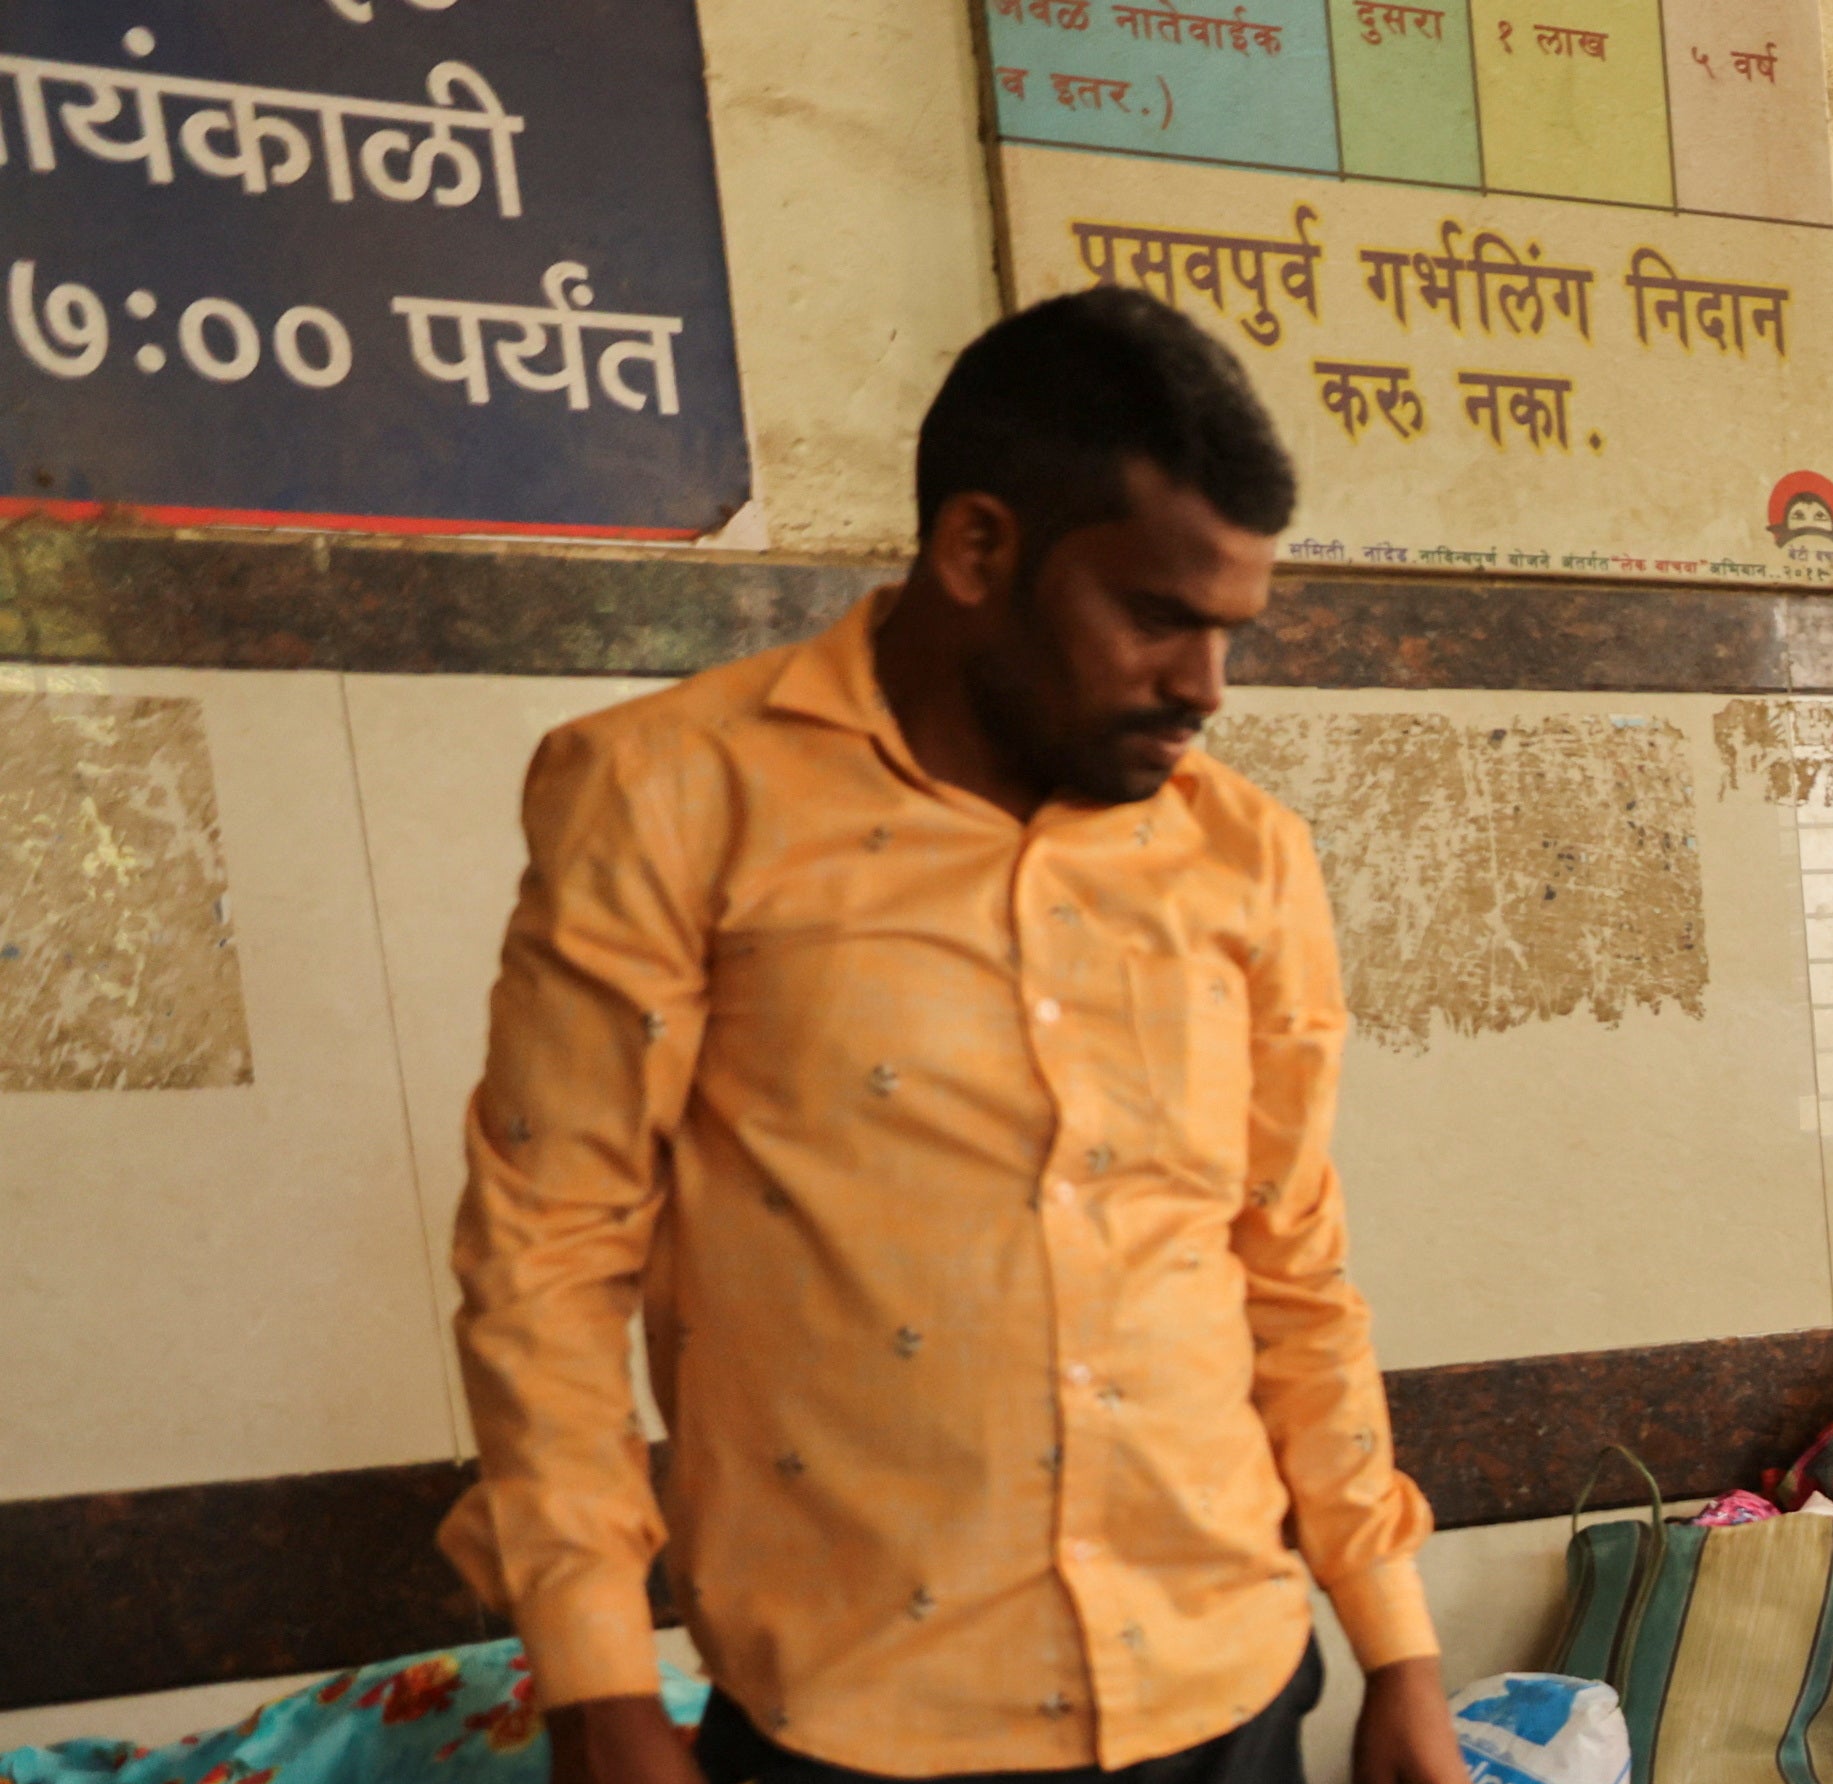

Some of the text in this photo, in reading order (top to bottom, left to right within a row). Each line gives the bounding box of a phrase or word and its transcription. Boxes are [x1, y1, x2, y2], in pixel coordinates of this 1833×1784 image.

[1353, 0, 1445, 45] दुसरा
[1534, 23, 1608, 62] लाख
[1731, 42, 1778, 85] वर्ष
[0, 26, 525, 218] ायंकाळी
[1359, 220, 1594, 341] गर्भलिंग
[1626, 248, 1791, 357] निदान
[390, 261, 683, 415] पर्यंत
